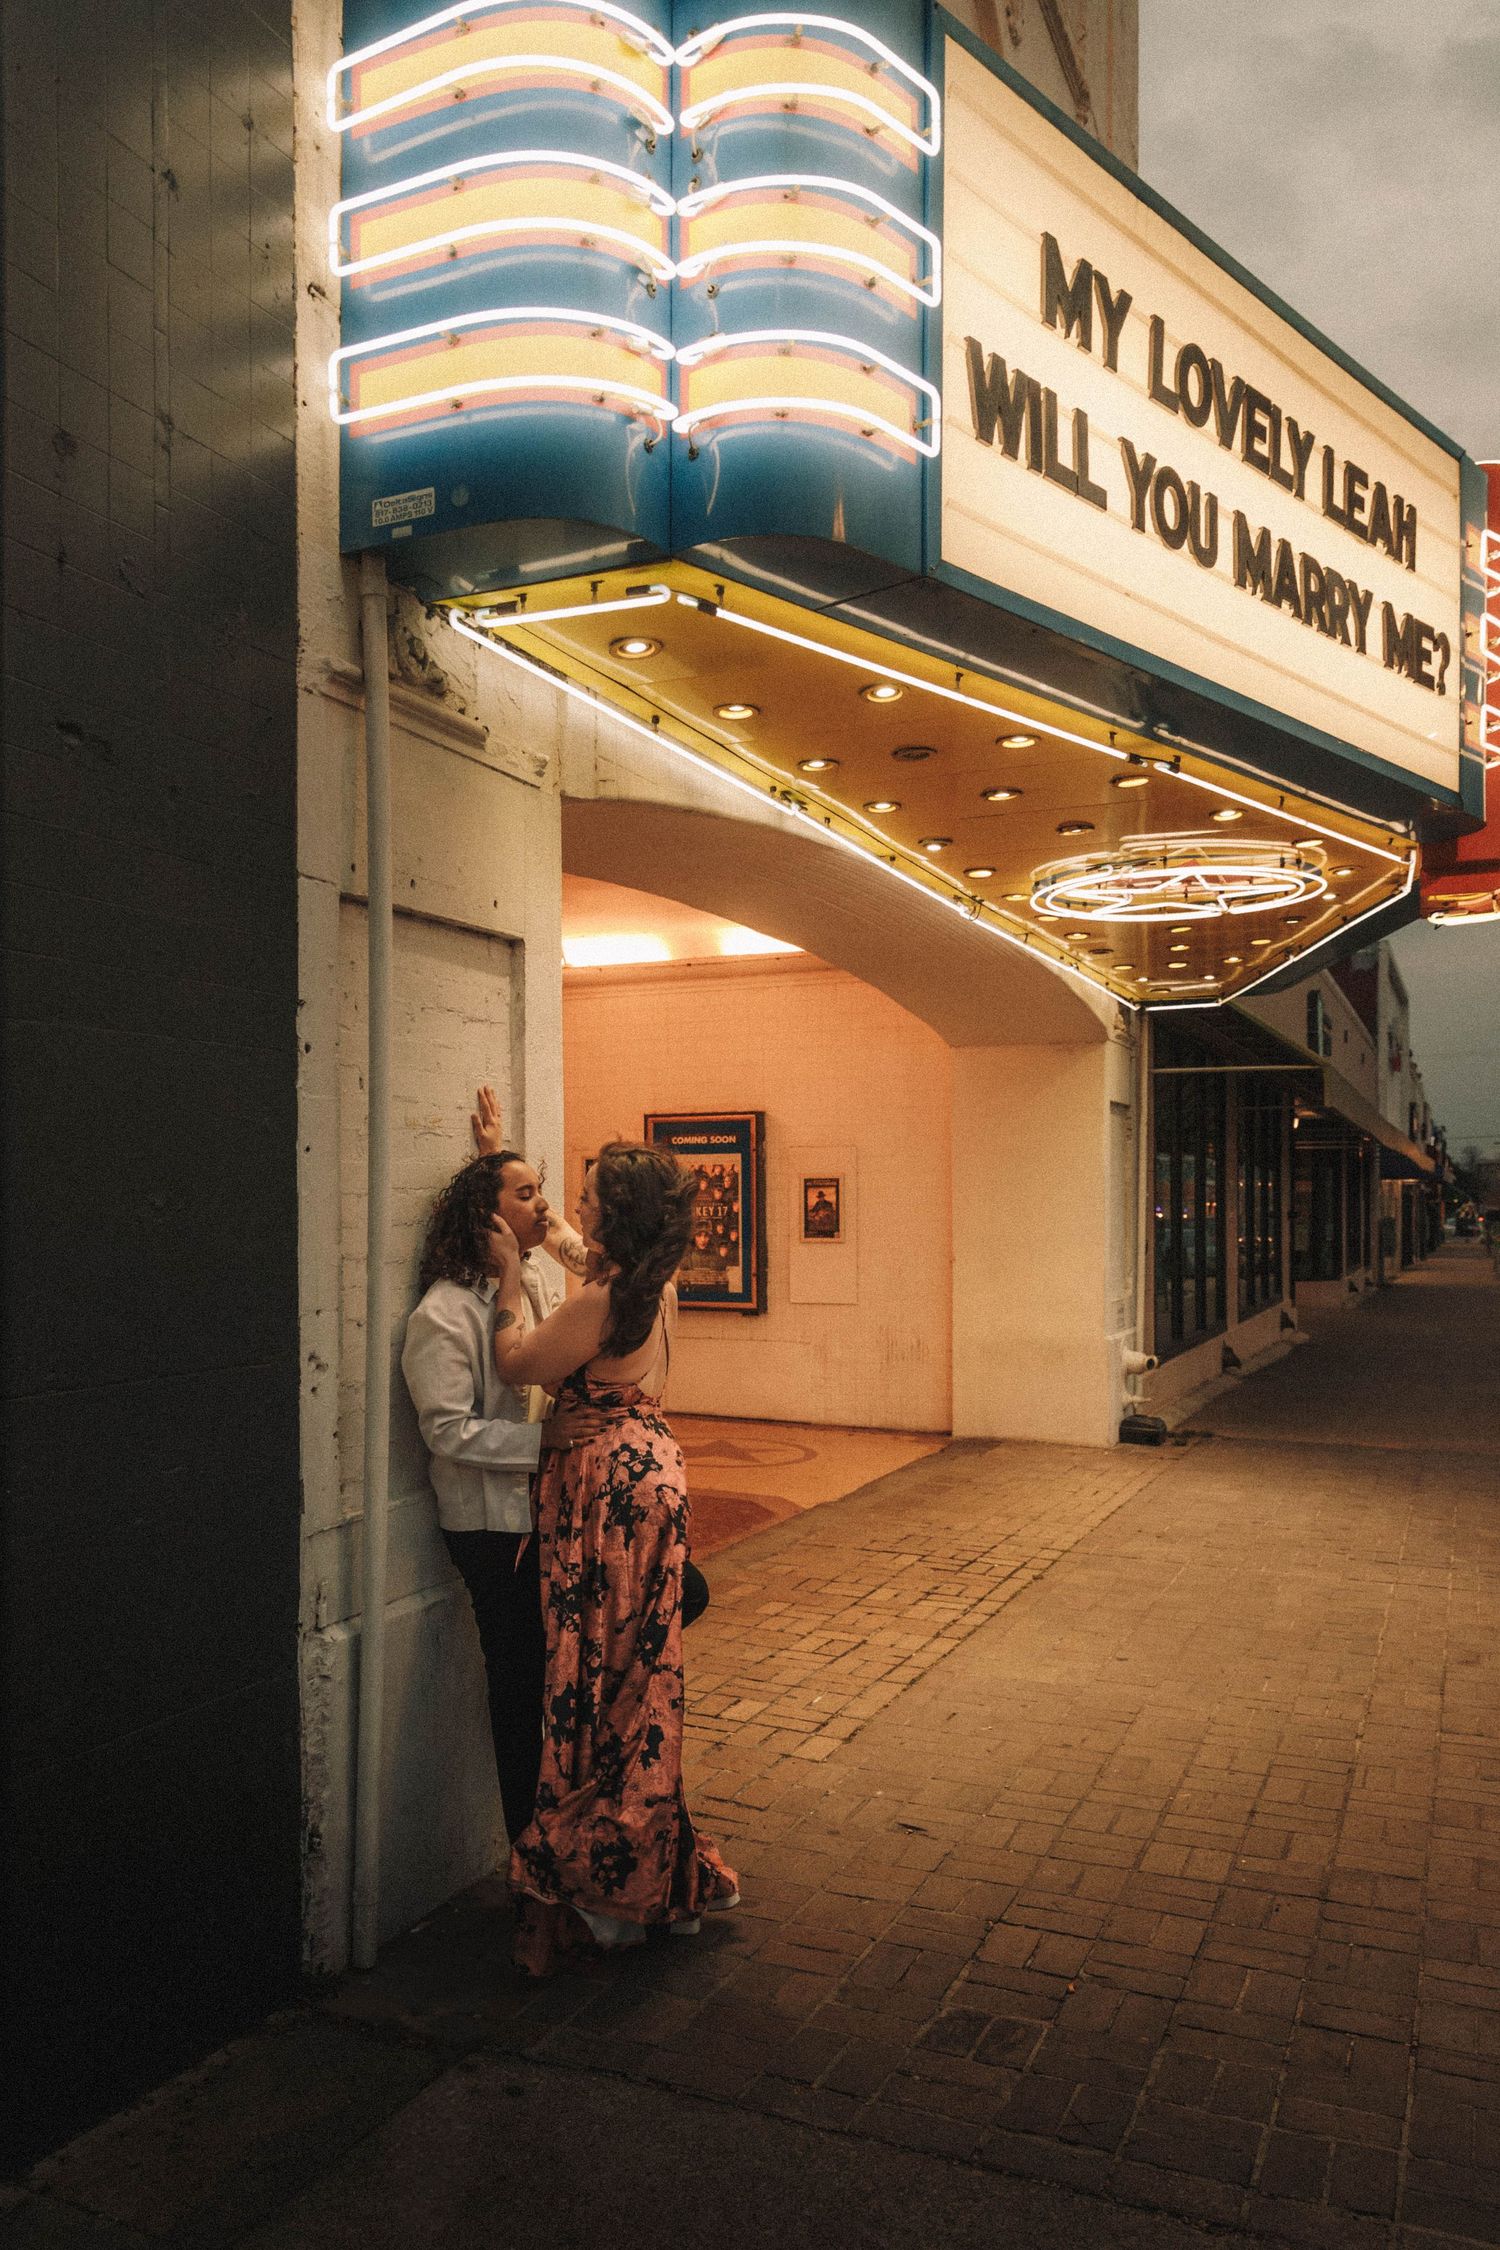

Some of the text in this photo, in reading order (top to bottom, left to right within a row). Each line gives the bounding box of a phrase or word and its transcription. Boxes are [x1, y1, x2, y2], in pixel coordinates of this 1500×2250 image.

[1040, 231, 1417, 572] MY LOVELY LEAH
[390, 511, 412, 522] AMPS
[964, 336, 1451, 696] WILL YOU MARRY ME?
[671, 1135, 737, 1145] COMING SOON
[695, 1206, 728, 1217] KEY 17
